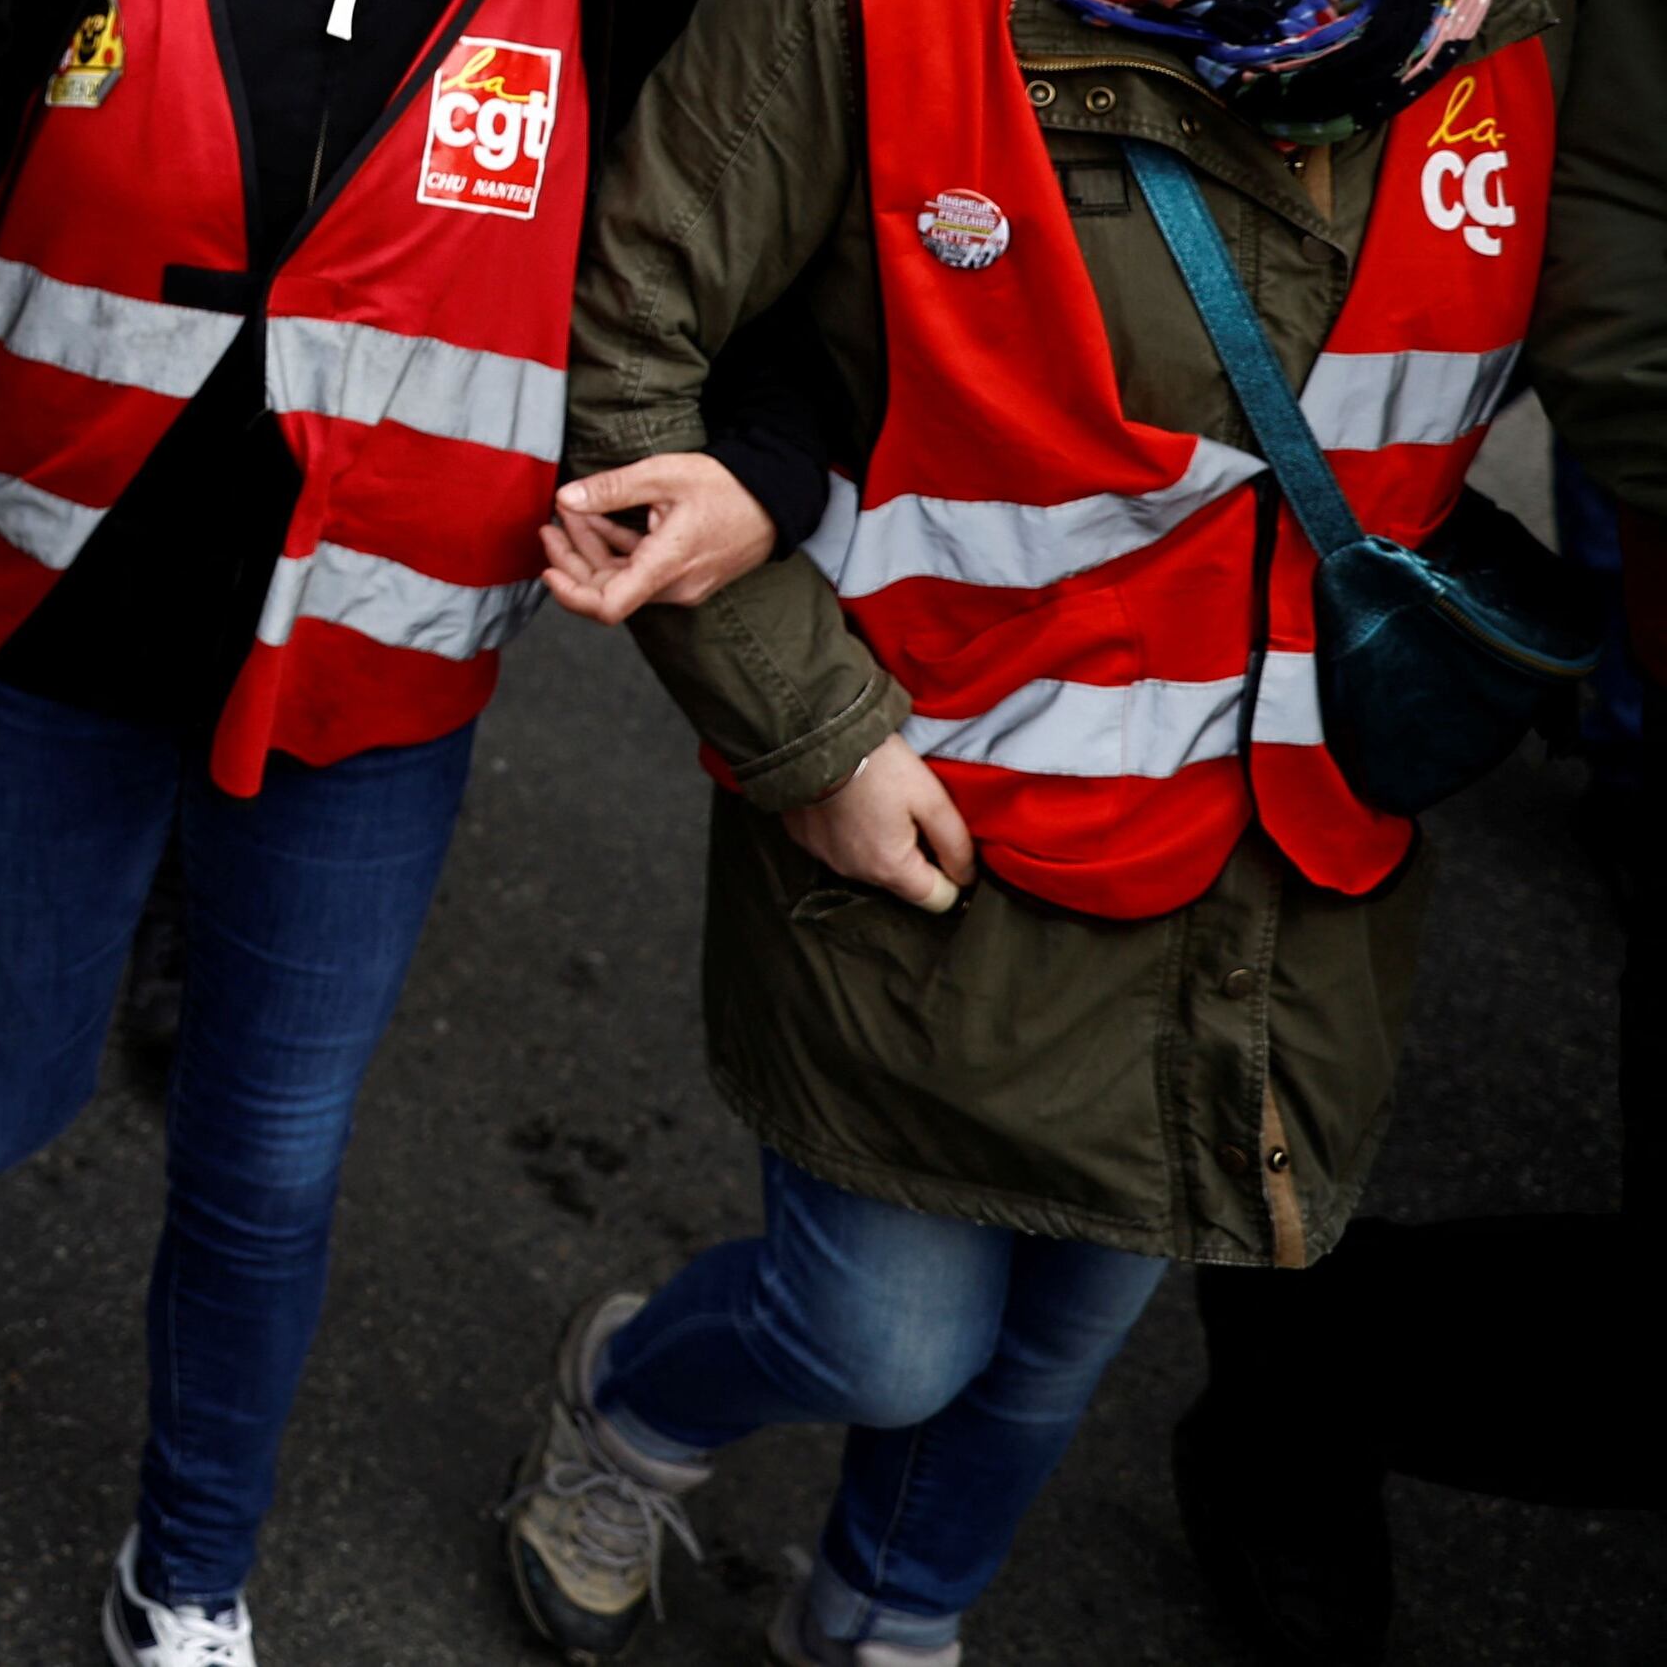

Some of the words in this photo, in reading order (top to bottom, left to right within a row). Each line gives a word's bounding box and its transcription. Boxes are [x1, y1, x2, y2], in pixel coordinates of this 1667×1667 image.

[435, 90, 551, 171] cgt
[1427, 76, 1506, 148] la
[427, 172, 468, 193] CHU
[472, 179, 534, 203] NANTES
